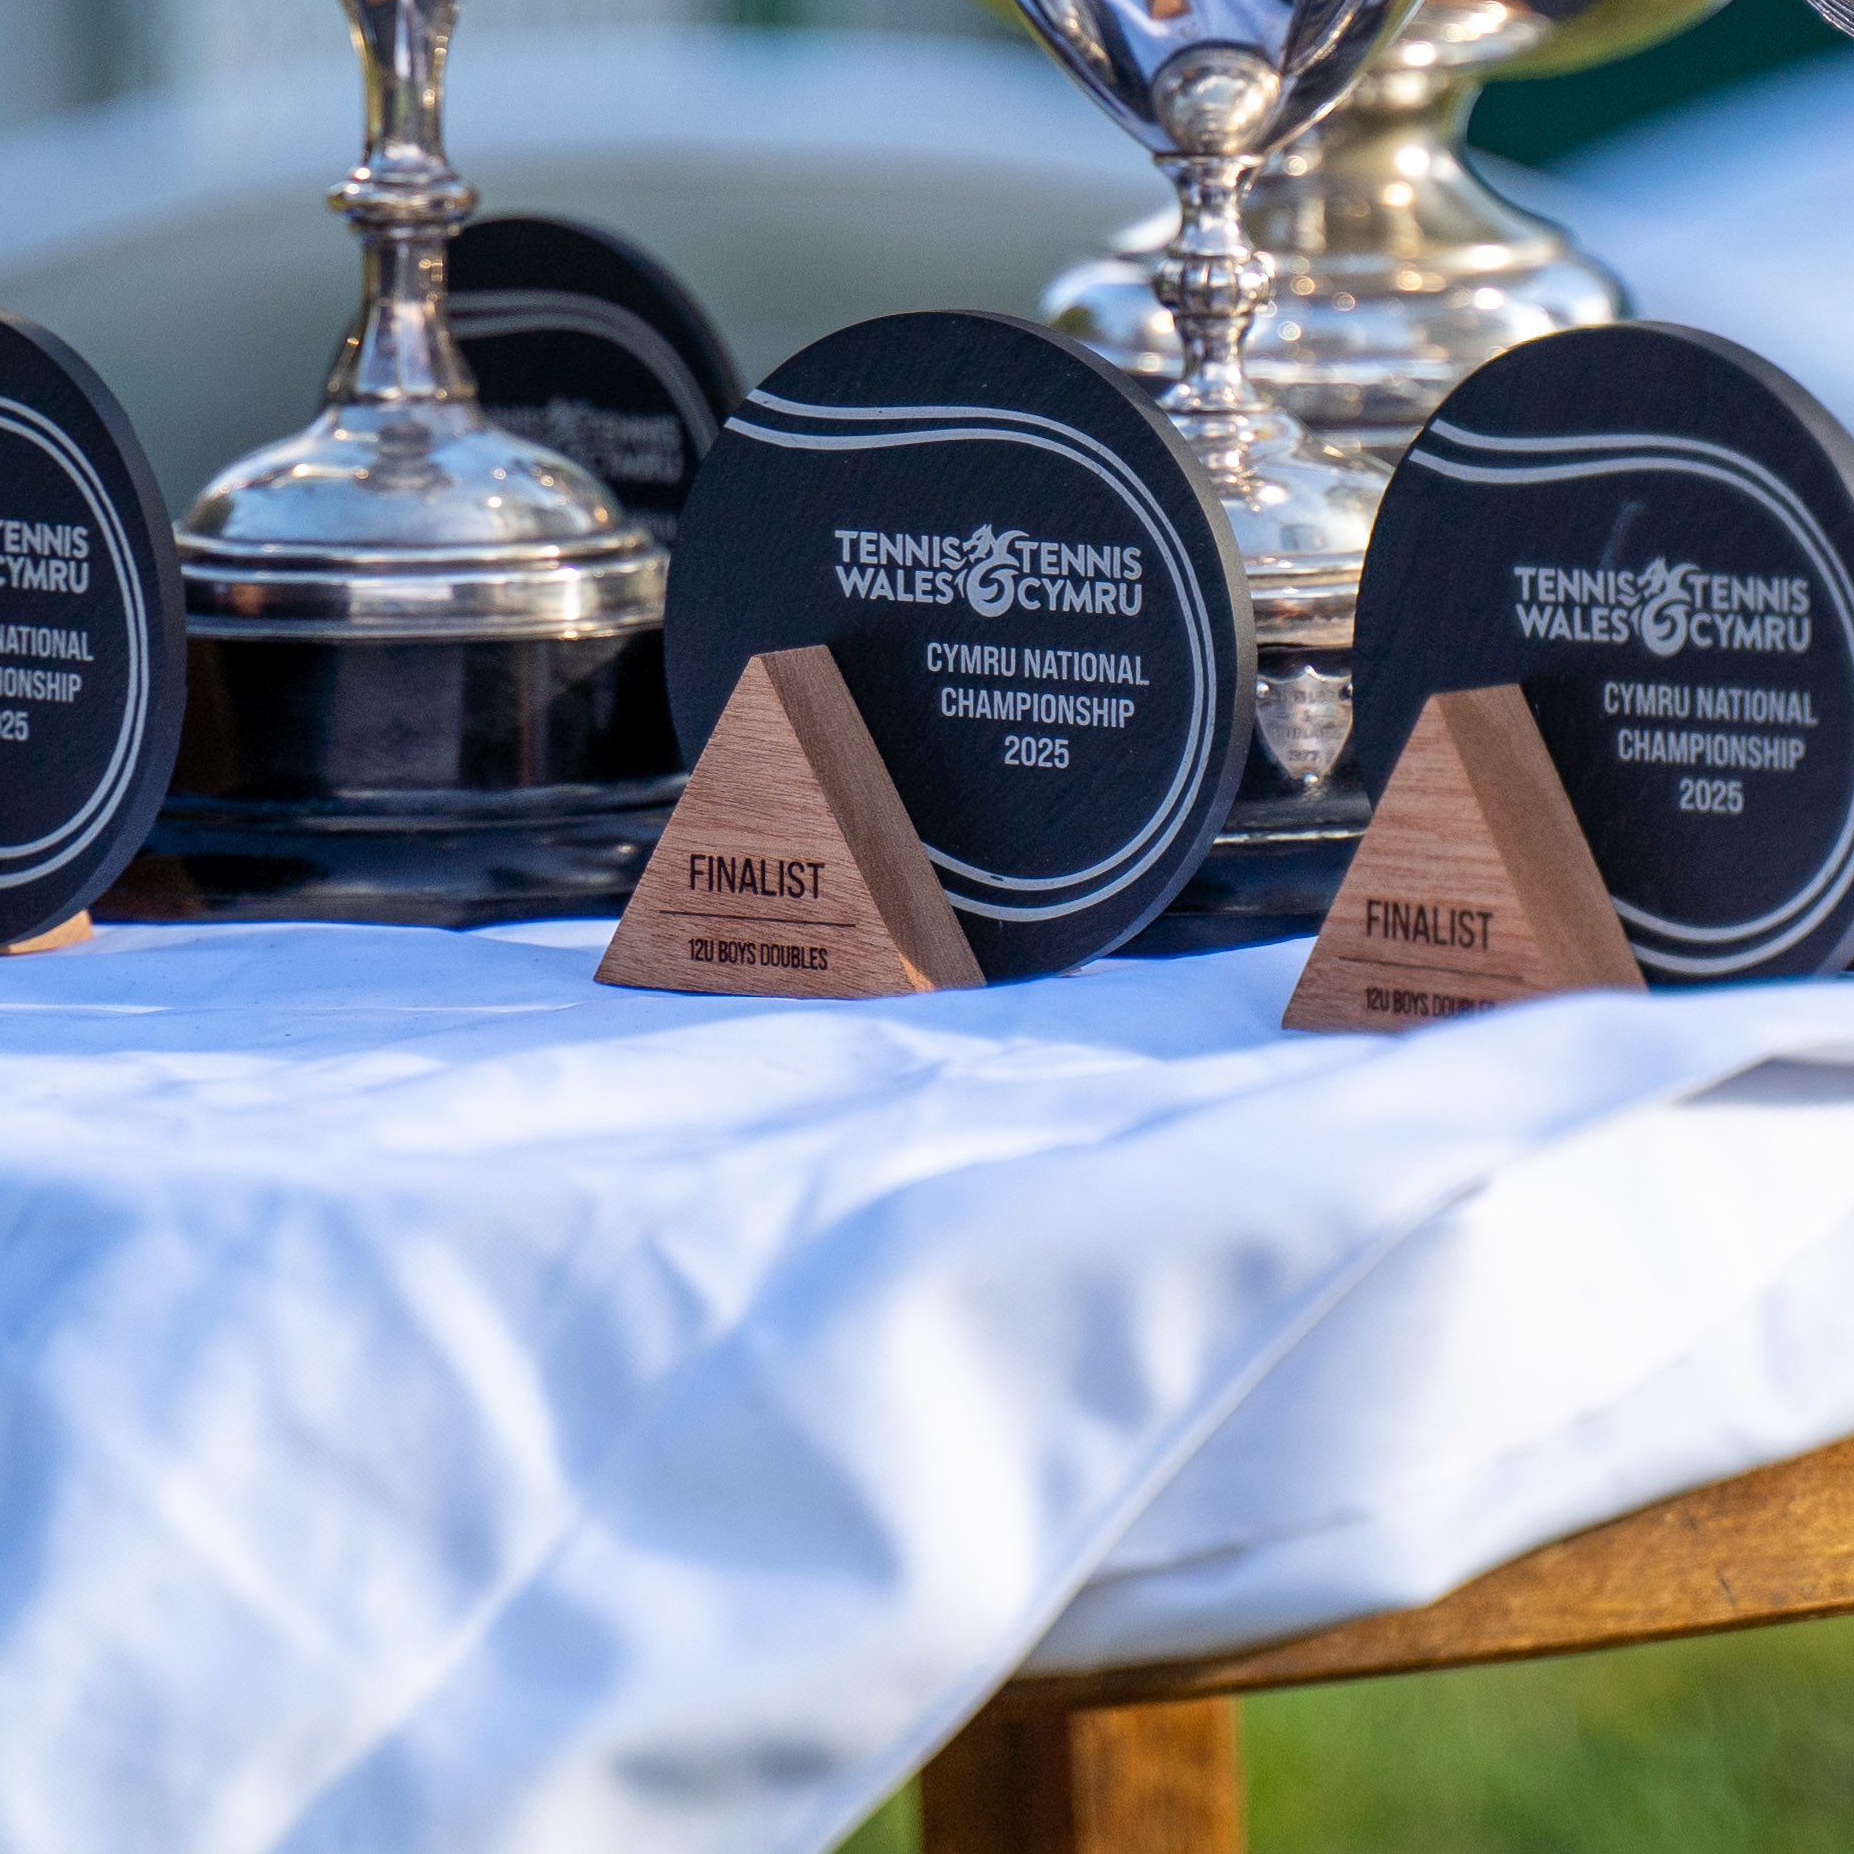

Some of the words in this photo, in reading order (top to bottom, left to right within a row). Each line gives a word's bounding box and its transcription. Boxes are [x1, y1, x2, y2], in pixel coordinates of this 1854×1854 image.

[835, 530, 962, 568] TENNIS
[1015, 540, 1143, 580] TENNIS
[835, 565, 955, 605] WALES
[1017, 577, 1142, 617] CYMRU
[1514, 566, 1639, 606] TENNIS
[1687, 574, 1810, 614] TENNIS
[1515, 602, 1629, 643] WALES
[1689, 612, 1812, 654] CYMRU
[927, 642, 1017, 678] CYMRU
[1024, 648, 1150, 686] NATIONAL
[940, 687, 1135, 729] CHAMPIONSHIP
[1603, 681, 1690, 719] CYMRU
[1695, 687, 1820, 727] NATIONAL
[1004, 735, 1070, 769] 2025
[1618, 728, 1806, 771] CHAMPIONSHIP
[1679, 778, 1744, 814] 2025
[690, 854, 825, 899] FINALIST
[1366, 898, 1494, 950] FINALIST
[688, 938, 714, 962] 12U
[718, 940, 756, 965] BOYS
[760, 943, 828, 970] DOUBLES
[1365, 986, 1390, 1012] 12U
[1392, 989, 1429, 1016] BOYS
